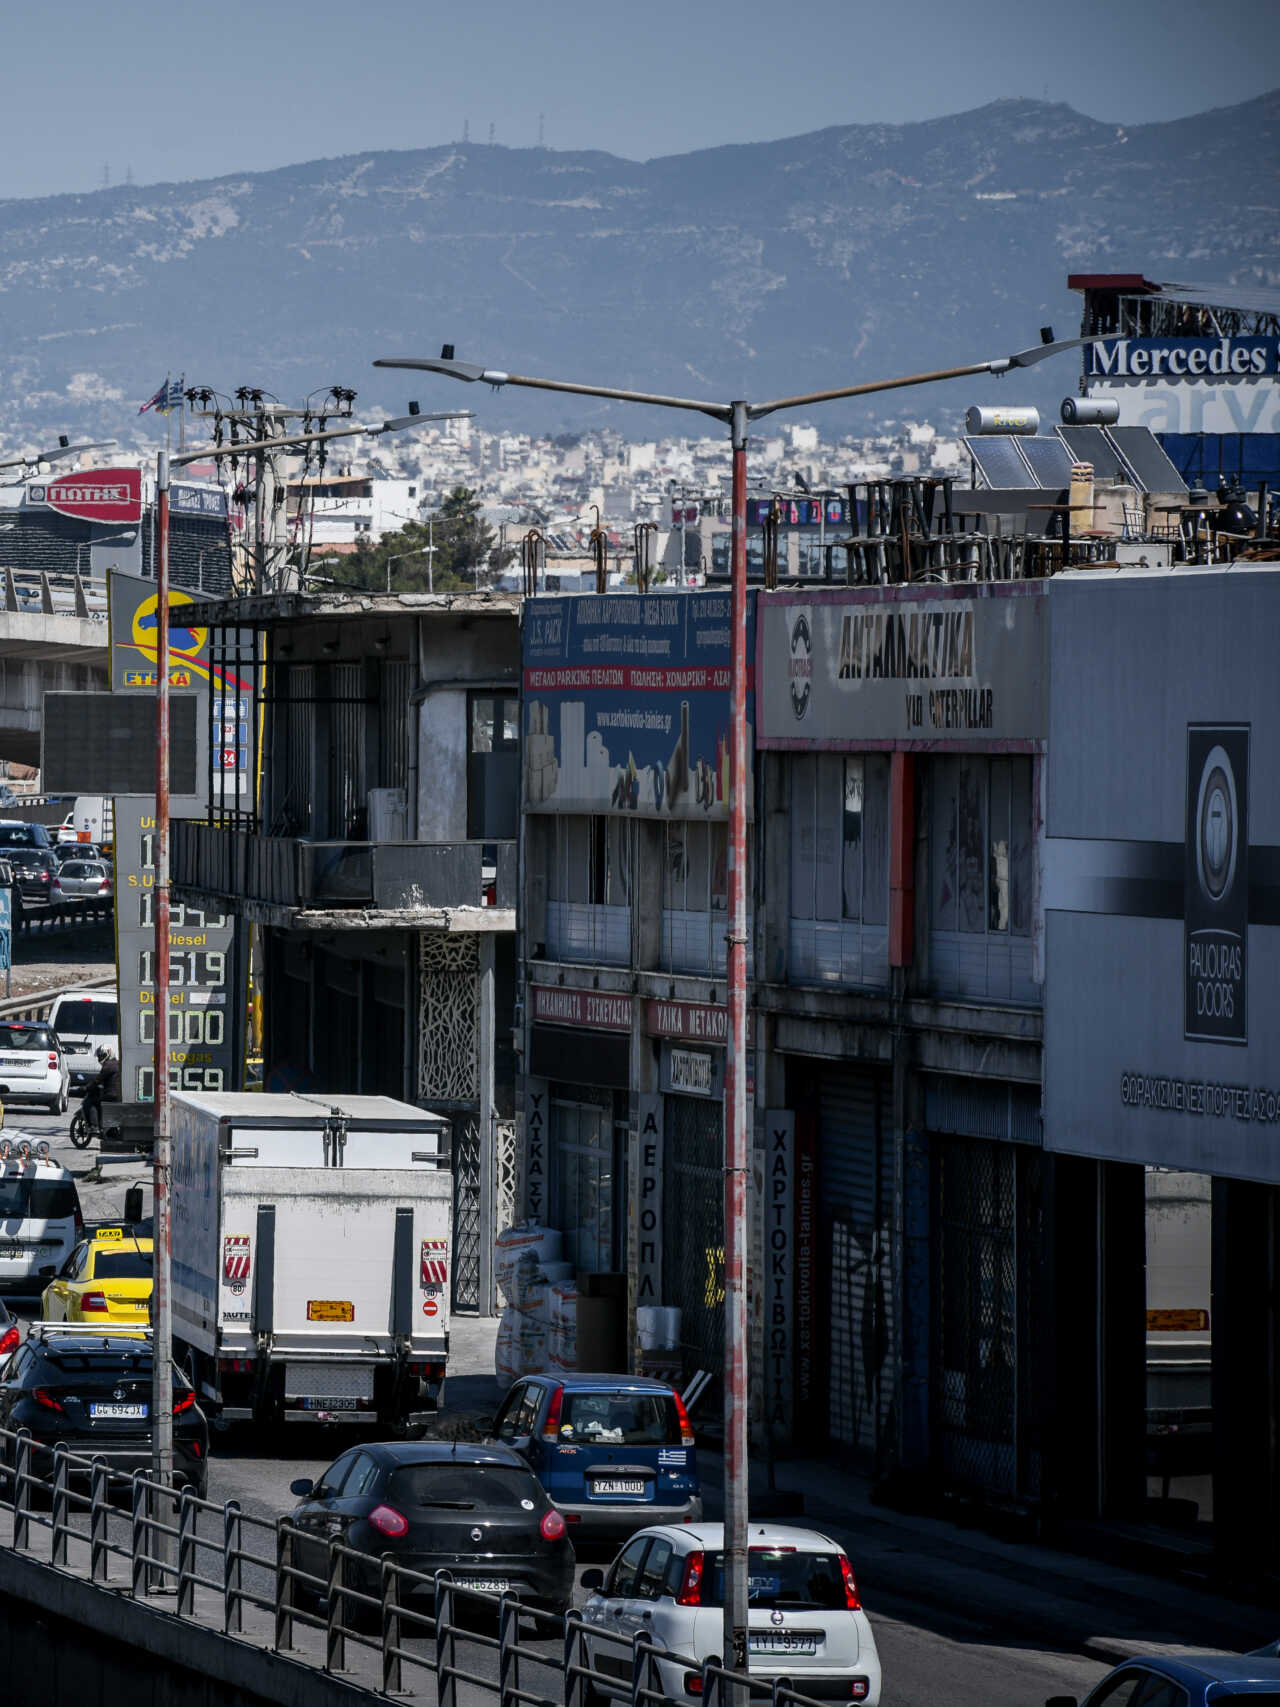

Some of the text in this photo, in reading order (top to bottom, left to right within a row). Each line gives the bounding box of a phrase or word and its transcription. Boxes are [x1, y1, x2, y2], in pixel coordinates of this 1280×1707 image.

[1089, 338, 1267, 376] Mercedes
[1139, 388, 1280, 435] arv
[556, 669, 591, 687] PARKING
[1190, 943, 1242, 981] PALIOURAS
[656, 1004, 683, 1033] ΥΛΙΚΑ
[1196, 981, 1235, 1019] DOORS
